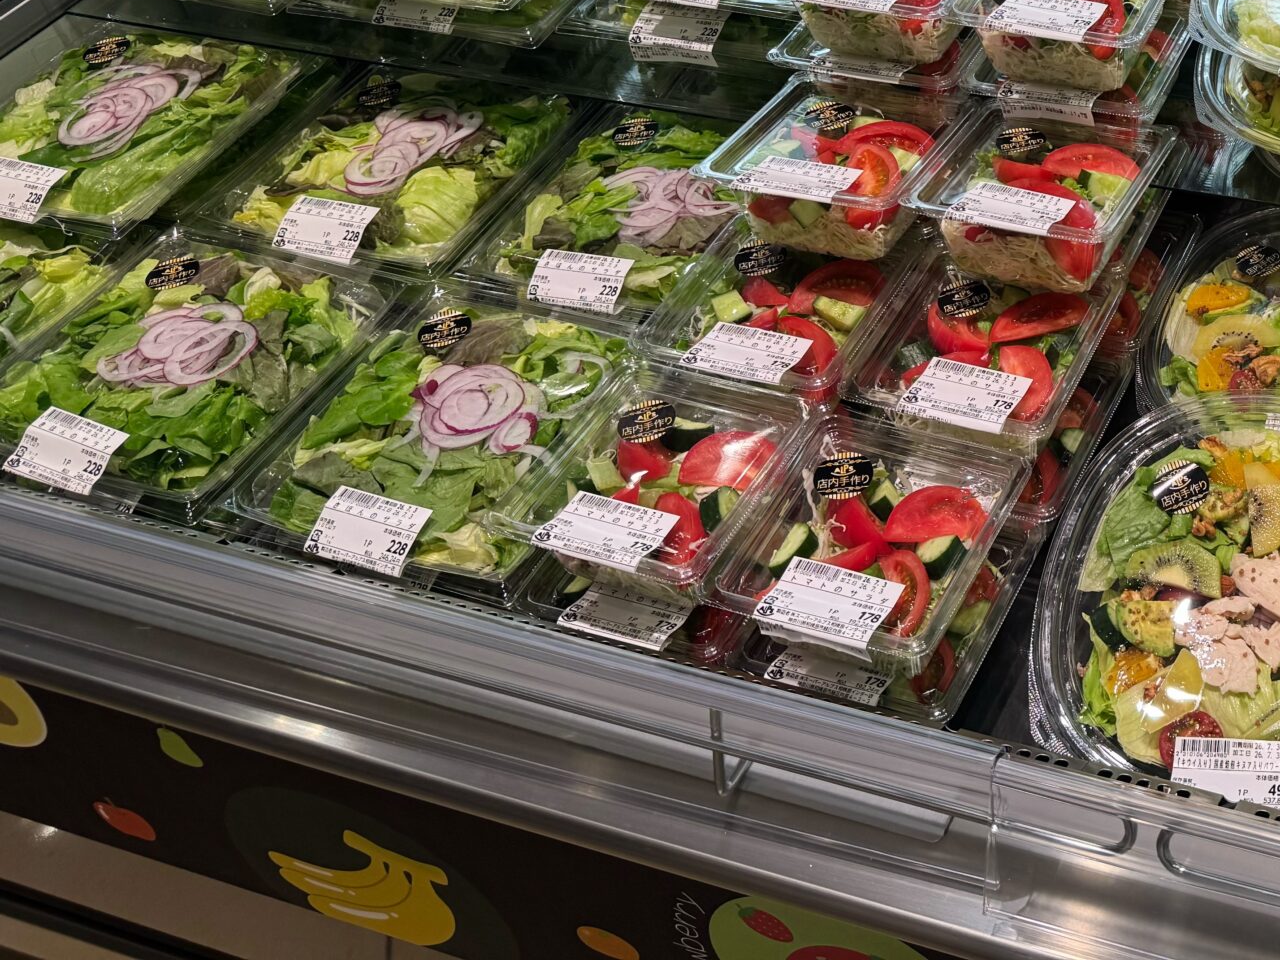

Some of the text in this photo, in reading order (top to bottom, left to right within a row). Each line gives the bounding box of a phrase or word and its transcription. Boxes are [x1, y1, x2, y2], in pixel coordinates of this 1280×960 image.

[438, 7, 456, 18] 228
[701, 27, 719, 37] 228
[25, 192, 43, 204] 228
[343, 230, 360, 242] 228
[148, 270, 195, 287] 店内手作り
[600, 285, 618, 297] 228
[420, 325, 467, 341] 店内手作り
[771, 360, 791, 369] 178
[993, 399, 1014, 410] 178
[622, 417, 672, 436] 店内手作り
[83, 460, 102, 476] 228
[816, 472, 870, 490] 店内手作り
[1161, 480, 1208, 508] 店内手作り
[333, 502, 416, 529] きほんのサラダ
[386, 540, 408, 556] 228
[631, 541, 653, 552] 178
[791, 576, 889, 604] トマトのサラダ
[859, 612, 882, 623] 178
[655, 620, 677, 631] 178
[865, 676, 887, 688] 178
